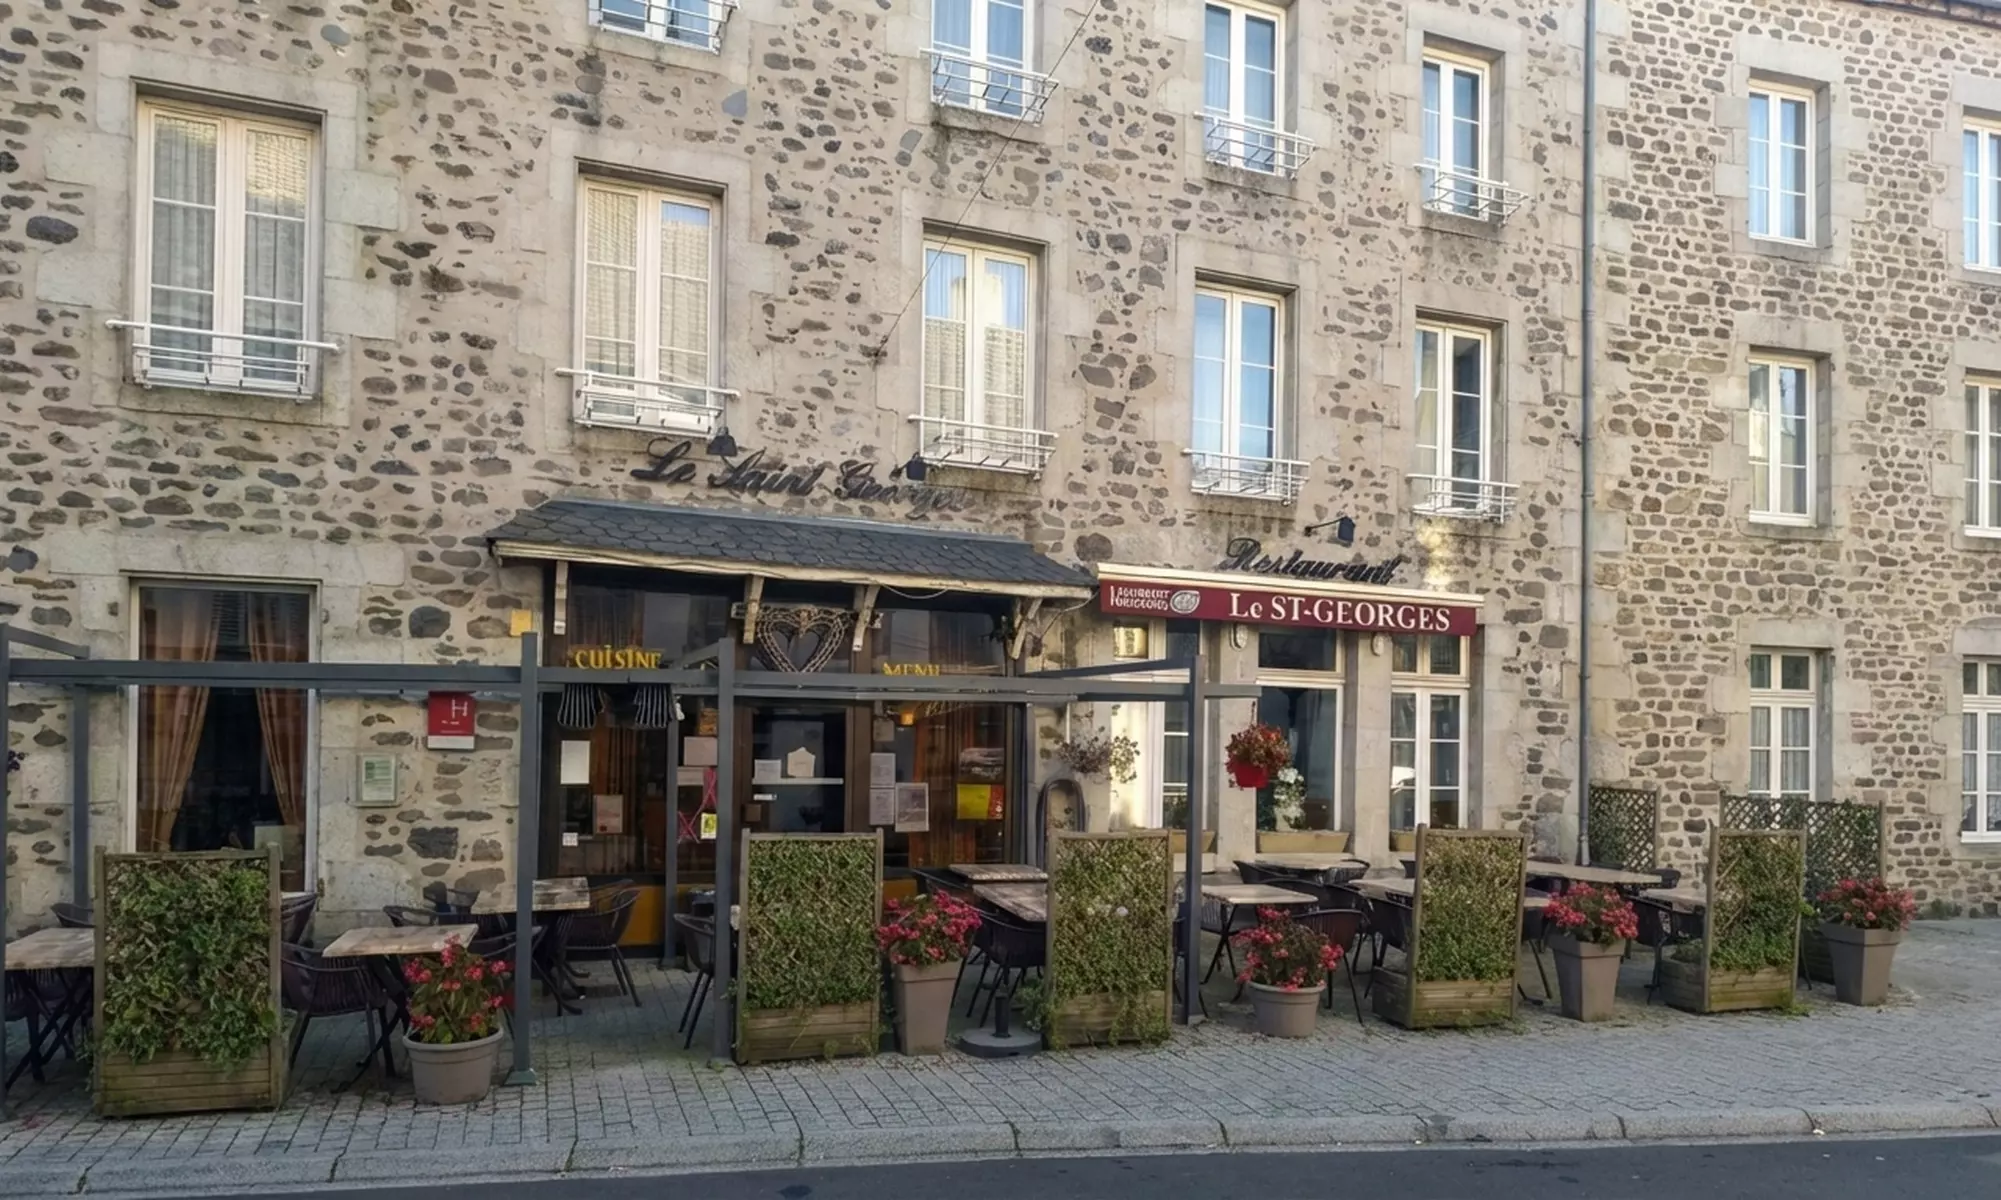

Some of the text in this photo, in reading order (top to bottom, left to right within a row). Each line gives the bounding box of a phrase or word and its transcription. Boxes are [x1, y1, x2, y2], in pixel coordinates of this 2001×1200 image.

[630, 436, 696, 484] Le
[707, 446, 827, 498] Saint
[1220, 537, 1402, 586] Restaurant
[1229, 592, 1450, 632] Le ST-GEORGES
